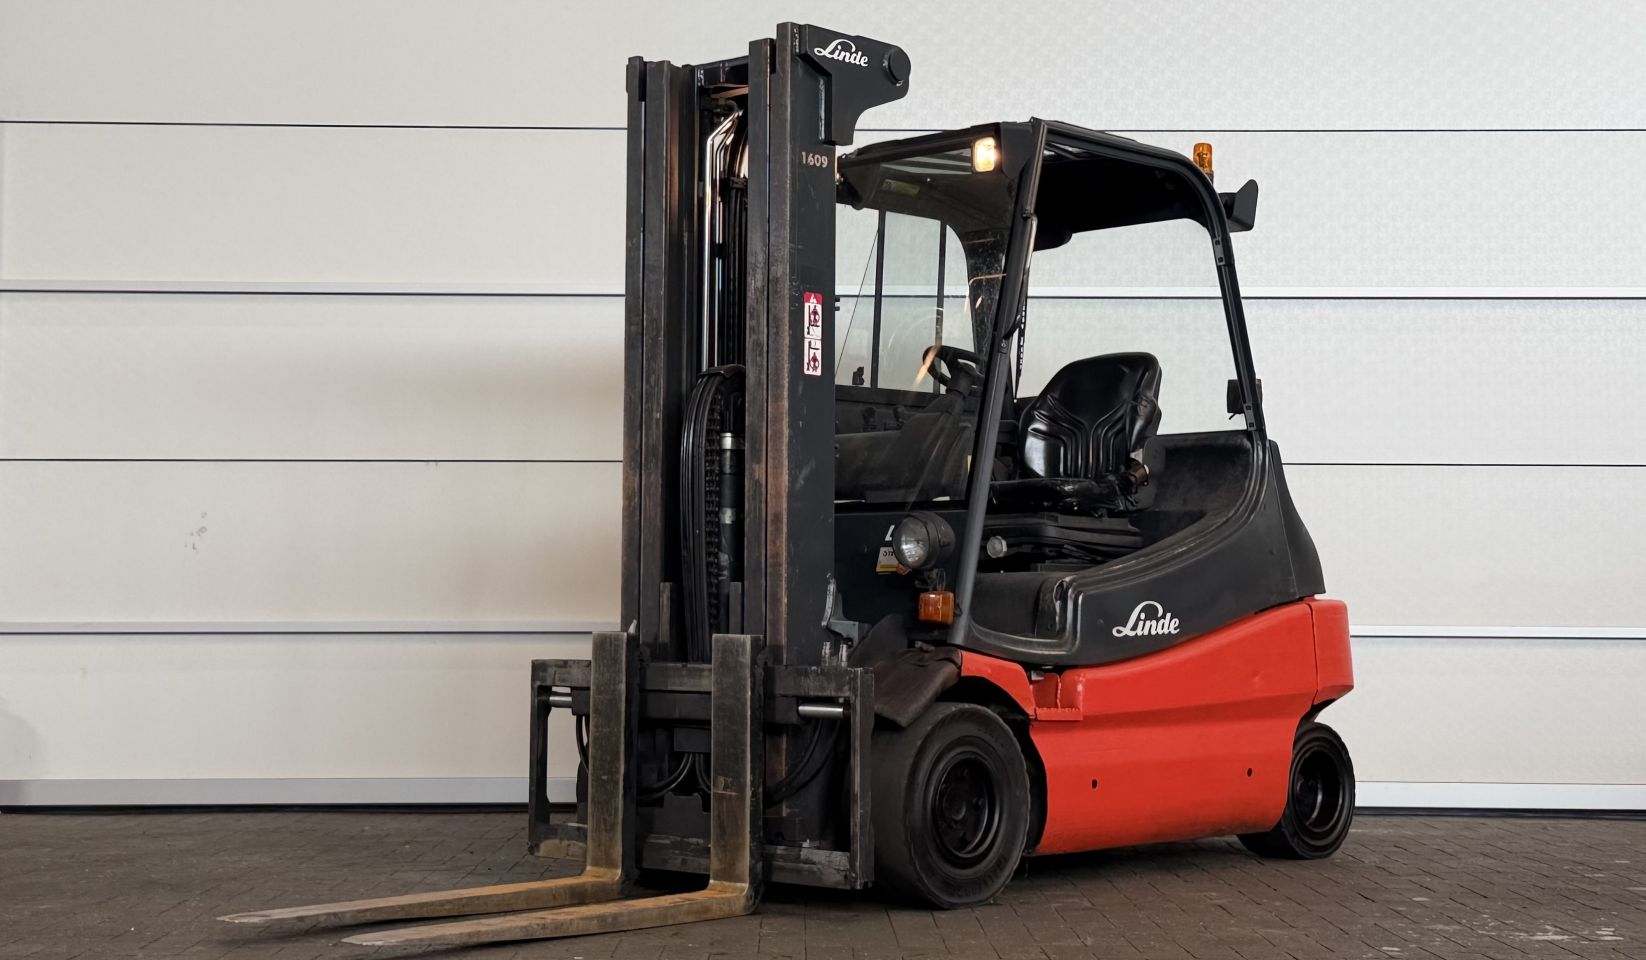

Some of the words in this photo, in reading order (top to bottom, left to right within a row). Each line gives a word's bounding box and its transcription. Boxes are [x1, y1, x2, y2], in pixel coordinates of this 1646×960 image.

[814, 39, 868, 67] Linde
[801, 151, 828, 168] 1609
[1112, 600, 1180, 637] Linde
